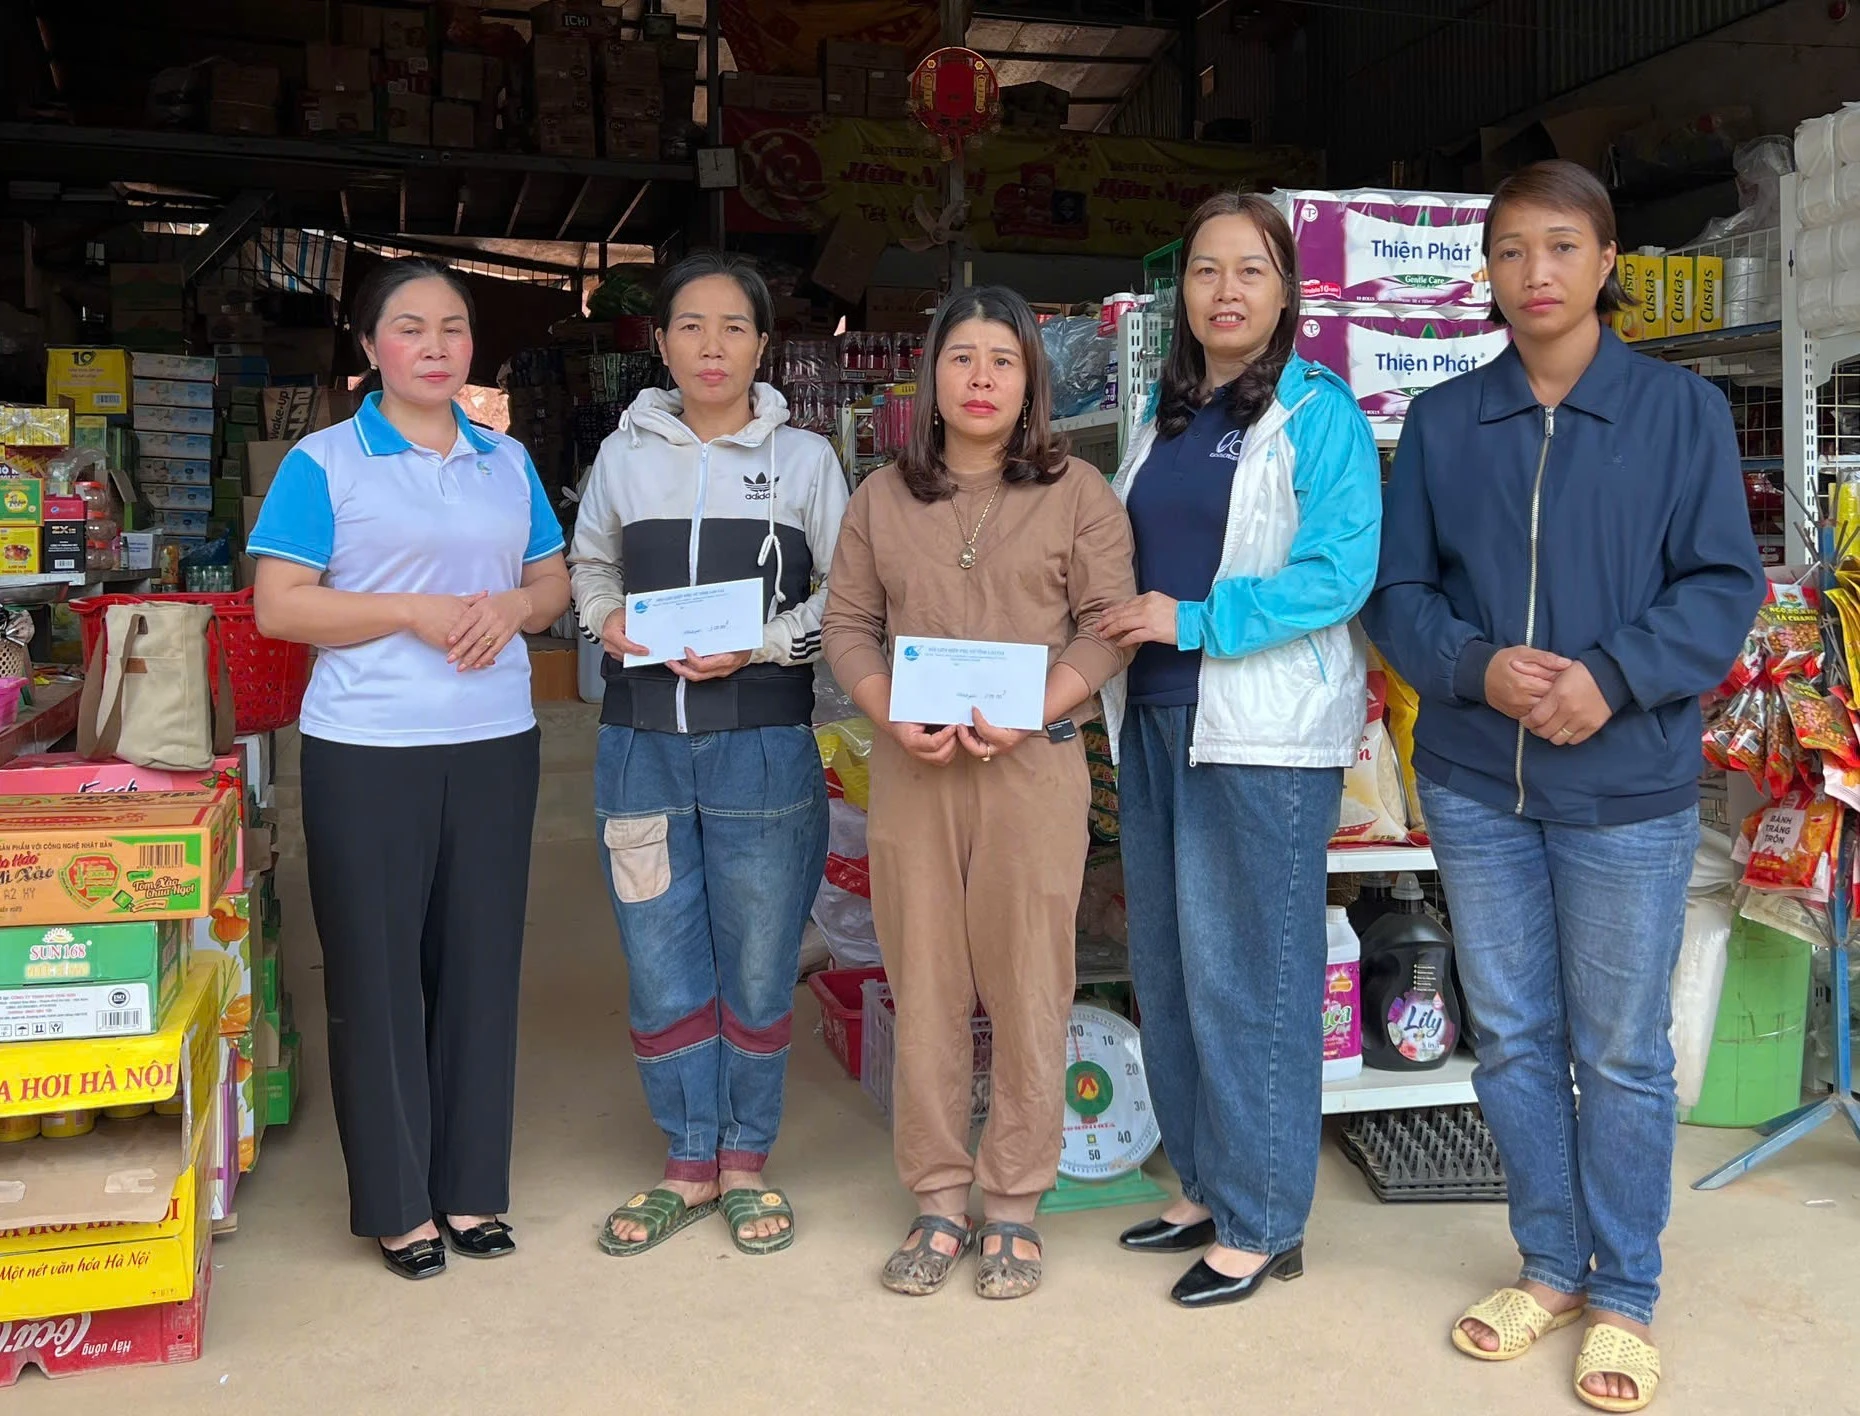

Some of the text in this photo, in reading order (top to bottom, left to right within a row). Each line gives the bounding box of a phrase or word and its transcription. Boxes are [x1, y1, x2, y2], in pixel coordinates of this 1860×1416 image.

[564, 15, 589, 27] ICHI
[1371, 240, 1471, 262] Thiện Phát
[1405, 275, 1445, 284] Gentle Care
[1643, 268, 1656, 323] Custas
[1671, 269, 1684, 323] Custas
[1700, 269, 1713, 323] Custas
[1375, 353, 1477, 375] Thiện Phát
[1765, 824, 1791, 835] TRÁNG
[43, 841, 61, 850] CÔNG
[12, 851, 39, 867] Hảo
[15, 866, 54, 883] Xào
[147, 883, 195, 899] Chua Ngọt
[155, 876, 180, 890] Xào
[1404, 1005, 1442, 1038] Lily
[1102, 1035, 1114, 1046] 10
[1125, 1063, 1139, 1076] 20
[20, 1073, 72, 1101] HƠI
[79, 1063, 119, 1095] HÀ
[124, 1060, 174, 1094] NỘI
[1134, 1101, 1146, 1112] 30
[1117, 1130, 1132, 1144] 40
[1089, 1149, 1101, 1161] 50
[0, 1251, 151, 1284] Một nét văn hóa Hà Nội
[81, 1342, 107, 1359] uống
[110, 1339, 131, 1355] Hãy
